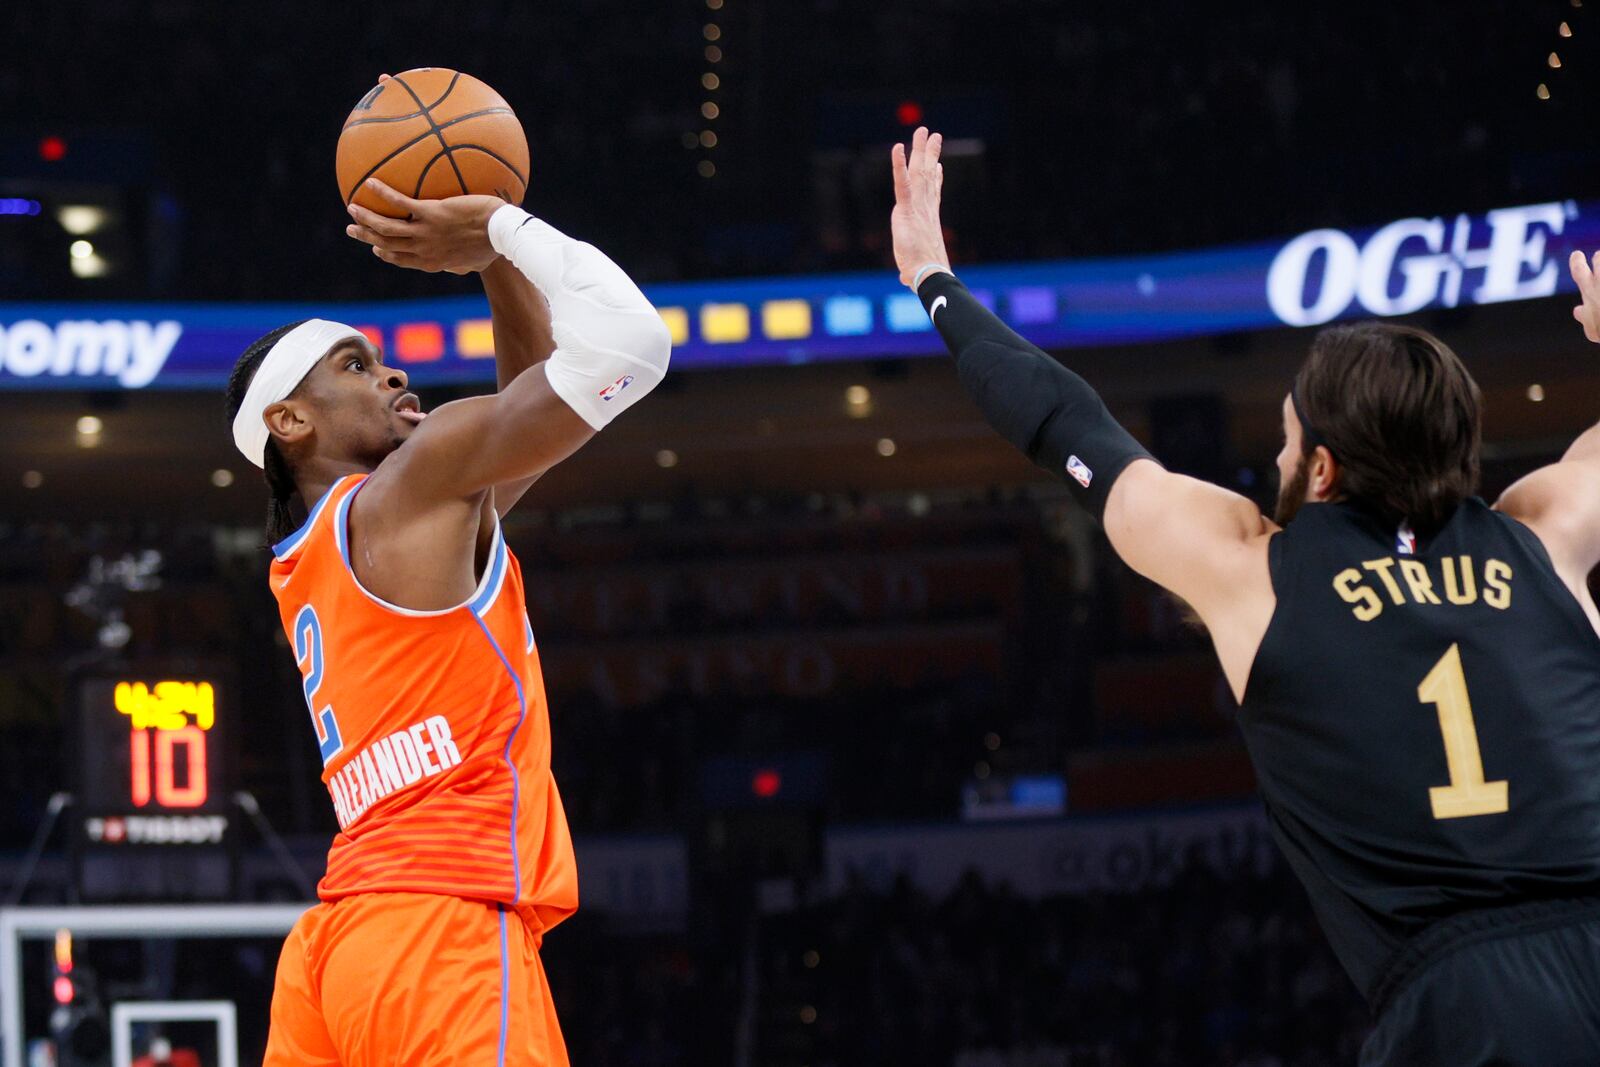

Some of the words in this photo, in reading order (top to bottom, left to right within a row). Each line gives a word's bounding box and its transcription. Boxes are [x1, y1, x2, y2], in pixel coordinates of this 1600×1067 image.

[0, 319, 183, 389] omy
[1332, 554, 1513, 622] STRUS
[294, 603, 344, 768] 2
[131, 725, 207, 808] 10
[1417, 642, 1509, 820] 1
